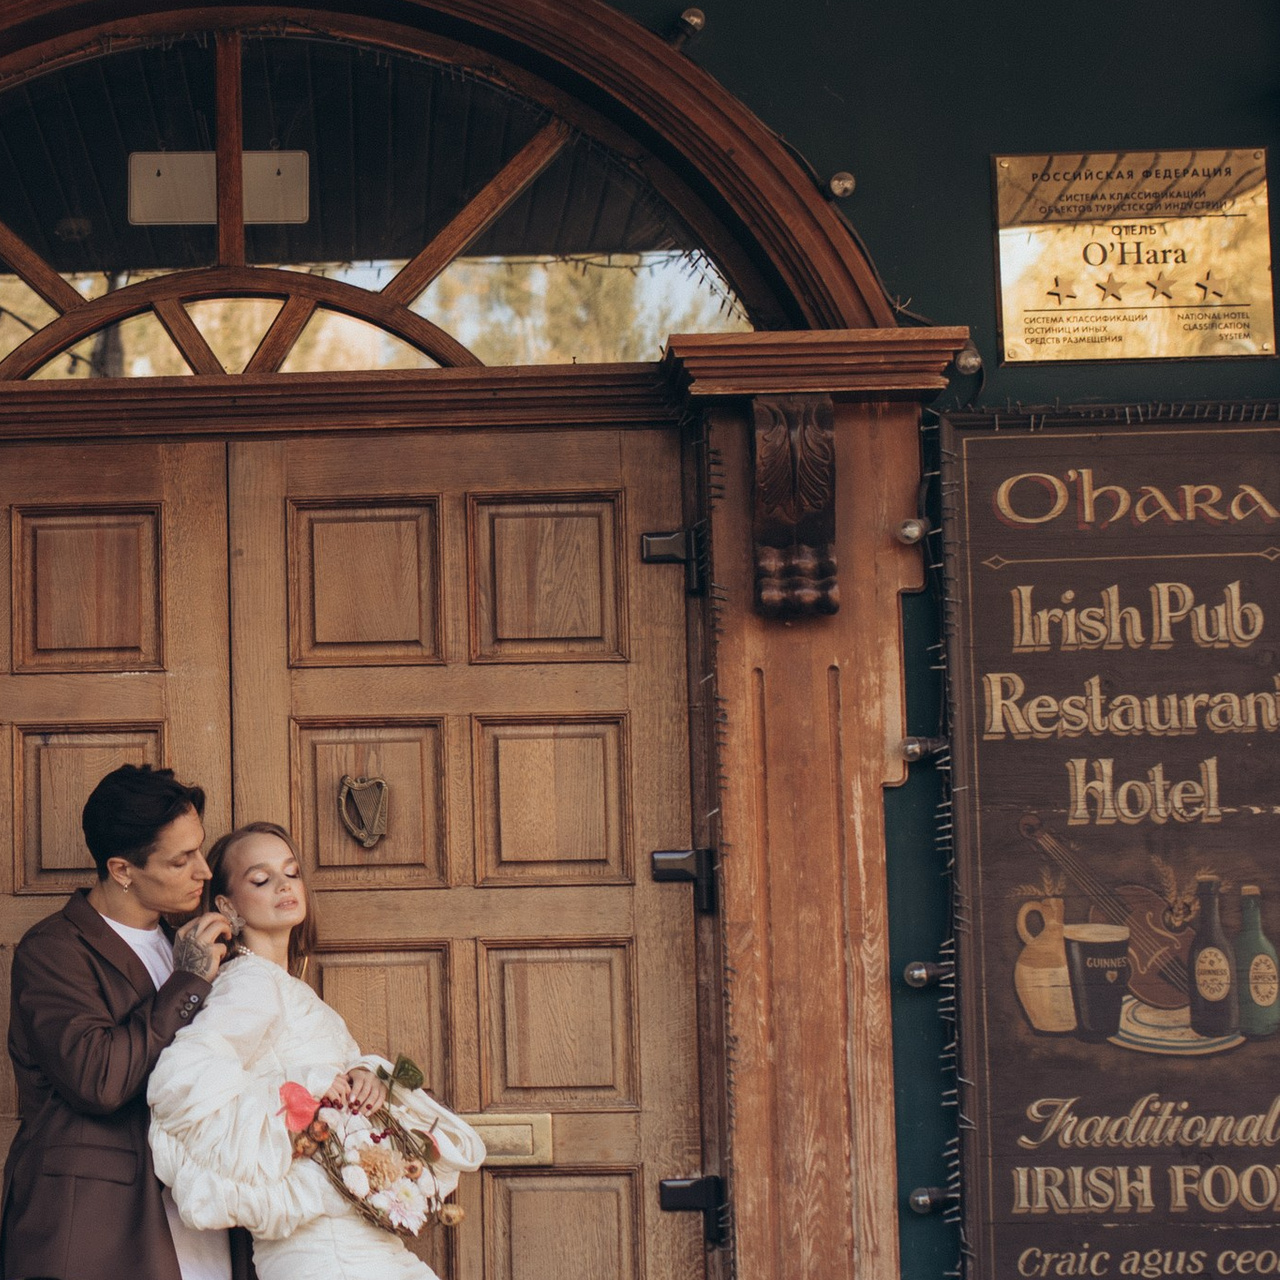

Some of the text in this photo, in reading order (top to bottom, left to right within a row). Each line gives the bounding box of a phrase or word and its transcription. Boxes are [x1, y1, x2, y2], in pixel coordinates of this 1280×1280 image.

[1031, 167, 1233, 183] РОССИЙСКАЯ ФЕДЕРАЦИЯ
[1058, 190, 1206, 202] СИСТЕМА КЛАССИФИКАЦИИ
[1039, 205, 1093, 215] ОБЪЕКТОВ
[1095, 202, 1162, 213] ТУРИСТСКОЙ
[1111, 225, 1157, 236] ОТЕЛЬ
[1082, 241, 1188, 267] O'Hara
[1023, 314, 1148, 325] СИСТЕМА КЛАССИФИКАЦИИ
[1177, 311, 1250, 321] NATIONAL HOTEL
[1024, 326, 1071, 335] ГОСТИНИЦ
[1082, 325, 1108, 333] ИНЫХ
[1183, 322, 1250, 331] CLASSIFICATION
[1025, 335, 1123, 345] СРЕДСТВ РАЗМЕЩЕНИЯ
[1218, 332, 1251, 341] SYSTEM
[1010, 580, 1264, 653] Irish Pub
[1065, 756, 1222, 825] Hotel
[1011, 1164, 1280, 1213] IRISH FOO
[1017, 1242, 1110, 1277] Craic
[1120, 1249, 1208, 1278] agus
